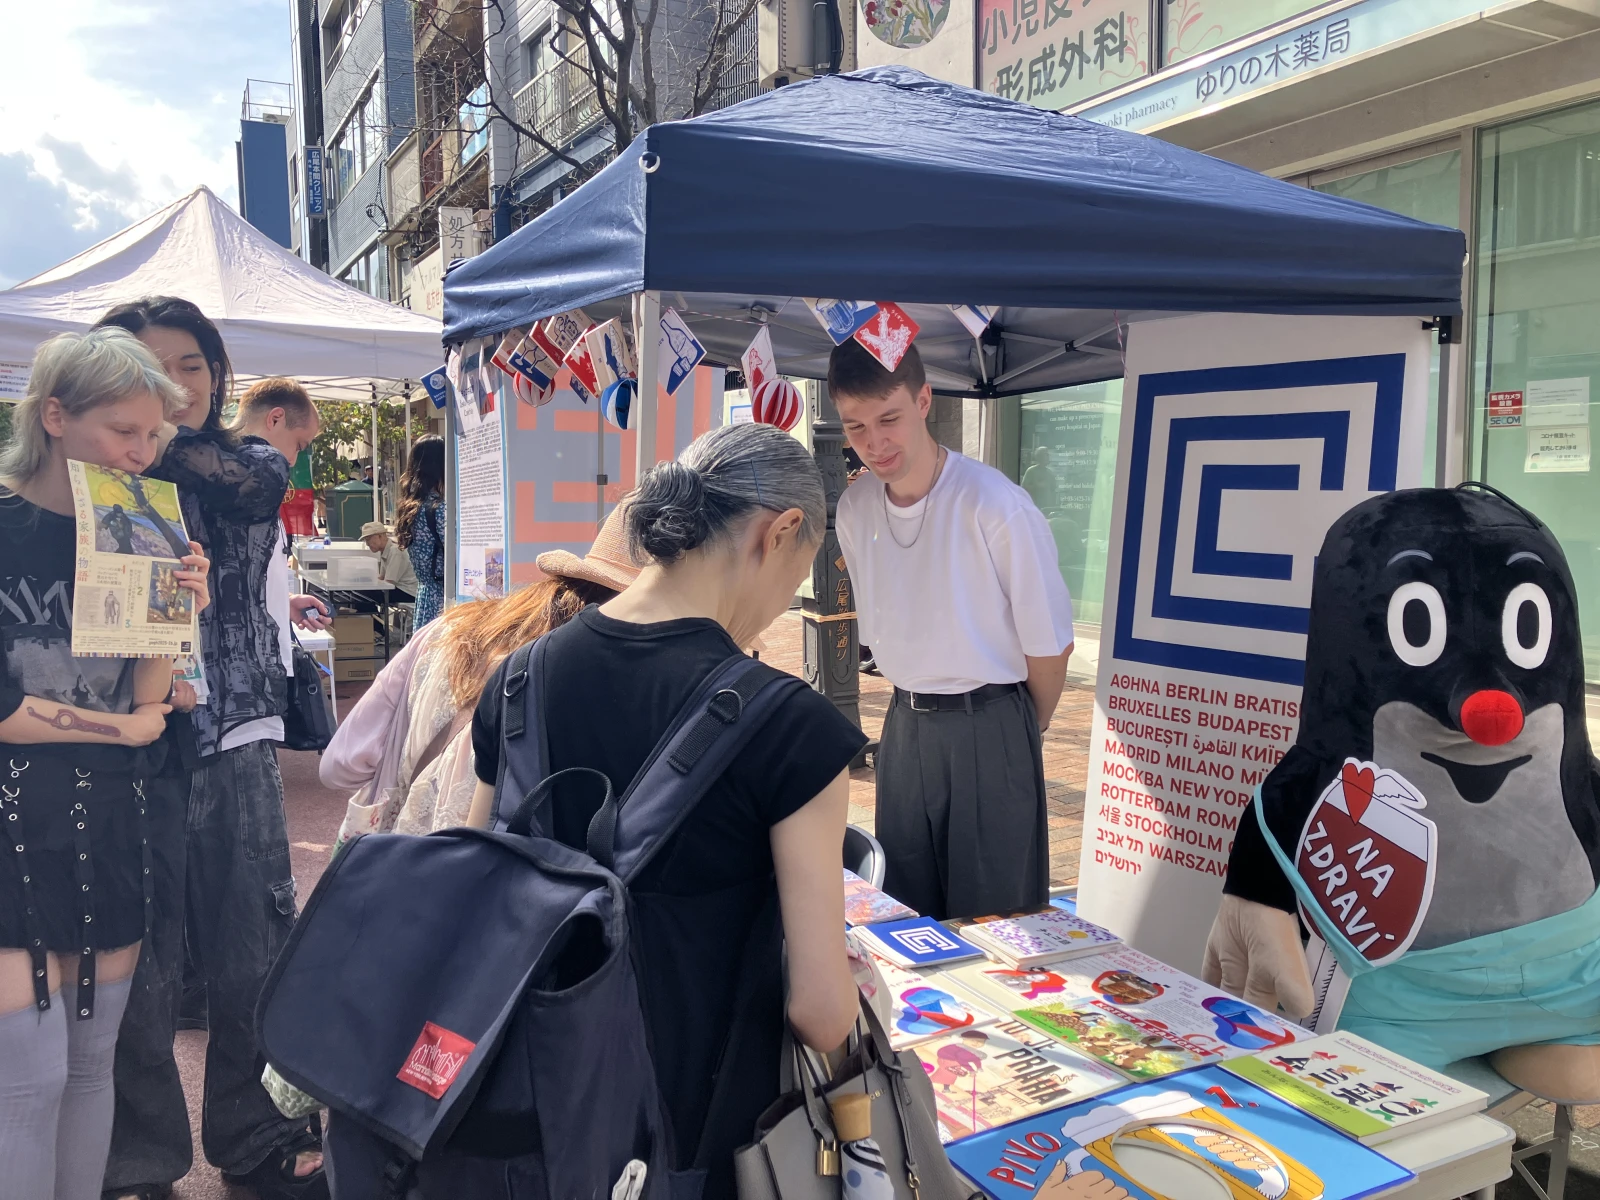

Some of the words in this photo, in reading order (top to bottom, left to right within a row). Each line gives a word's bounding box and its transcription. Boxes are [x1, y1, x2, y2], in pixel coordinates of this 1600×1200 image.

[982, 0, 1092, 55] 小児皮
[996, 11, 1128, 101] 形成外科
[1196, 18, 1351, 103] ゆりの木薬局
[1125, 95, 1178, 127] pharmacy
[1490, 416, 1521, 425] SECOM
[137, 586, 143, 596] 2
[1166, 683, 1228, 707] BERLIN
[1106, 717, 1188, 749] BUCUREȘTI
[1192, 733, 1237, 757] القاهرة
[1108, 695, 1191, 724] BRUXELLES
[1197, 711, 1293, 742] BUDAPEST
[1104, 739, 1161, 765] MADRID
[1166, 753, 1235, 781] MILANO
[1100, 783, 1191, 820] ROTTERDAM
[1169, 778, 1211, 799] NEW
[1099, 804, 1121, 825] 서울
[1124, 813, 1223, 852] STOCKHOLM
[1095, 849, 1142, 876] ירושלים
[1347, 837, 1395, 898] NA
[1302, 821, 1395, 954] ZDRAVÍ
[1095, 1002, 1136, 1021] KRTEK
[992, 1048, 1073, 1105] PRAHA
[986, 1131, 1063, 1191] PIVO
